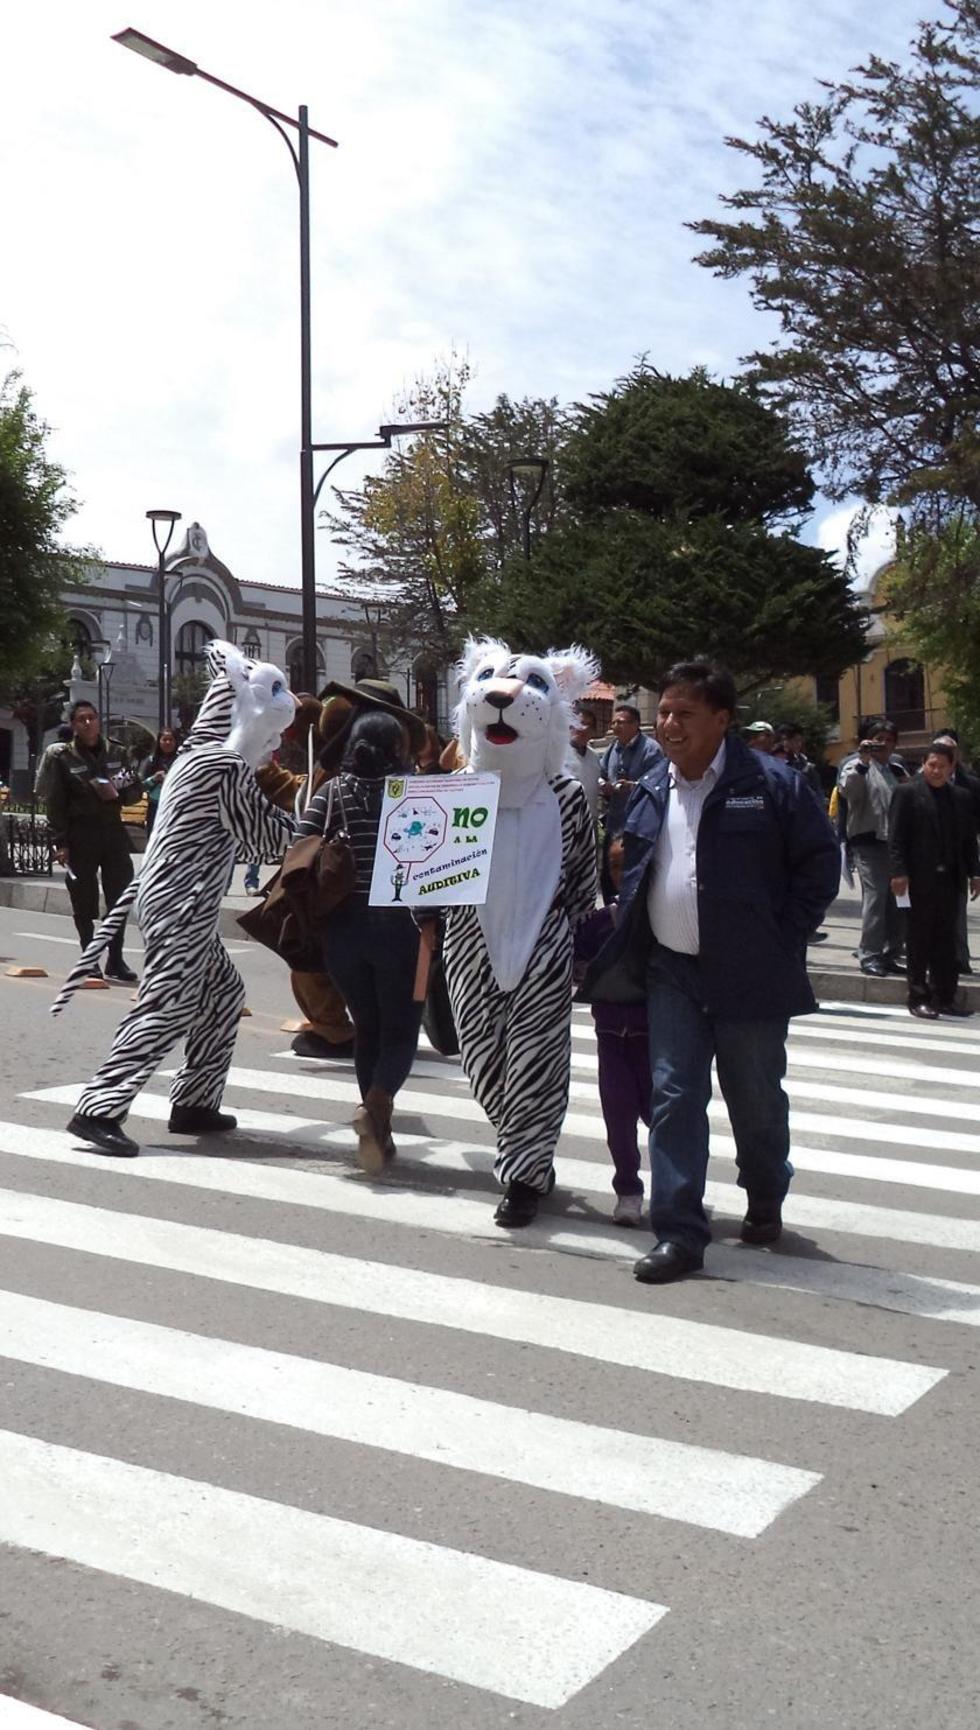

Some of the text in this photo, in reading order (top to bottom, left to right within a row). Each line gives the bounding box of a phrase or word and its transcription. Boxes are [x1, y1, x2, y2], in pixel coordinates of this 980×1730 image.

[452, 806, 488, 828] NO
[412, 849, 488, 880] contaminación
[418, 867, 480, 895] AUDITIVA
